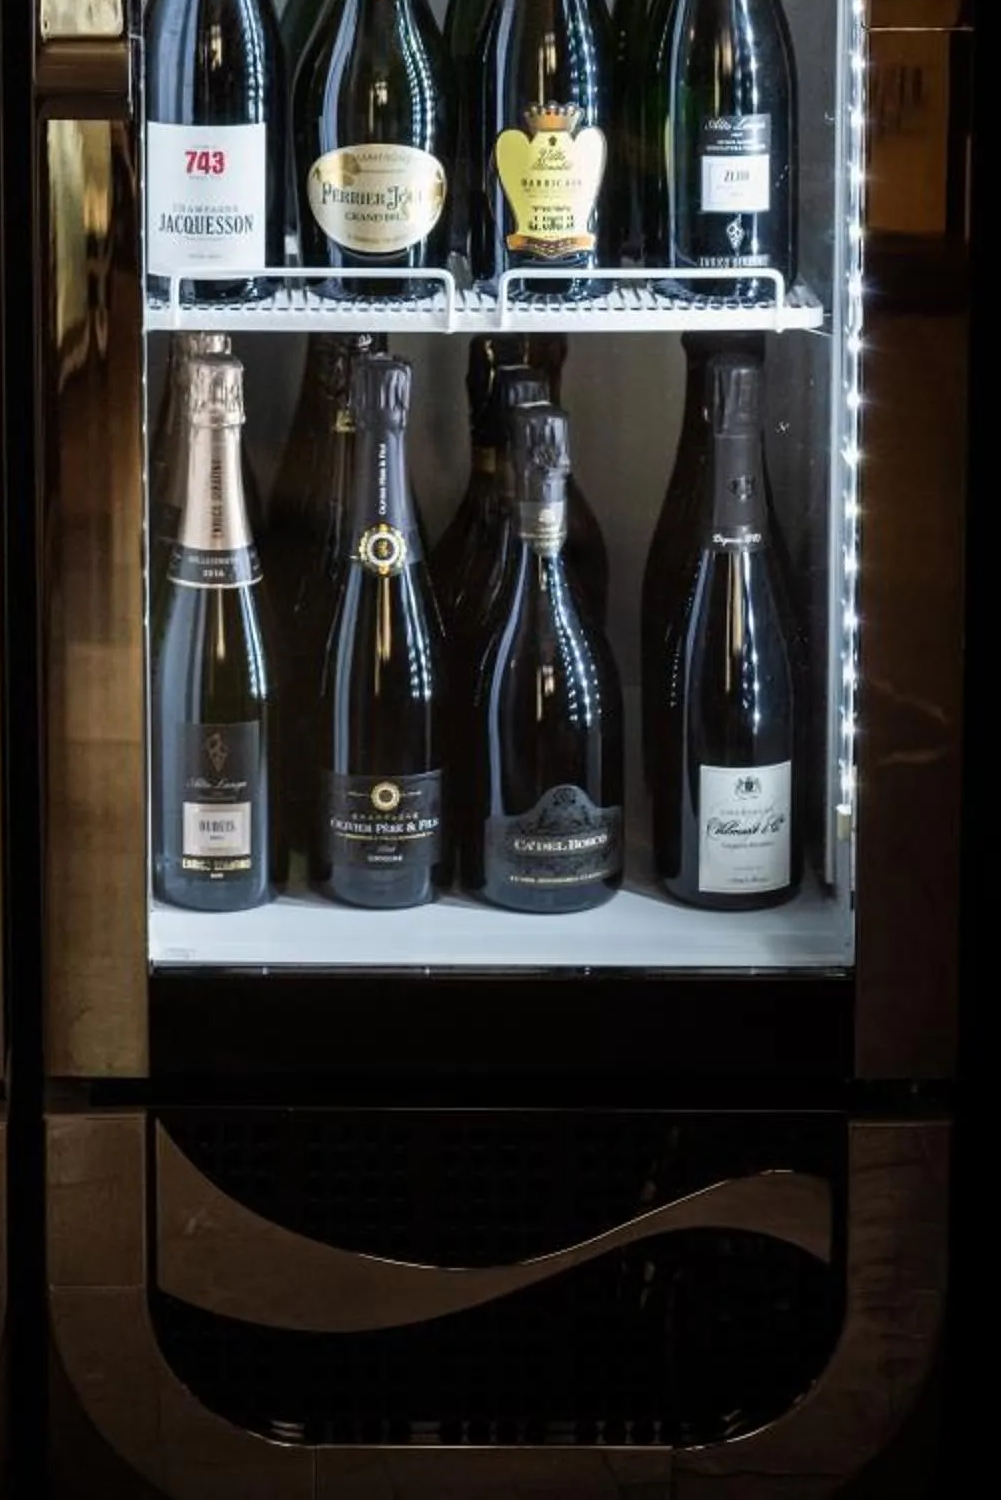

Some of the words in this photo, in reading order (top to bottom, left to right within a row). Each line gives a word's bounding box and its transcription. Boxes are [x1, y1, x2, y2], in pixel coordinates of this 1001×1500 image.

[184, 150, 226, 175] 743
[158, 213, 254, 235] JACQUESSON
[406, 821, 416, 833] &
